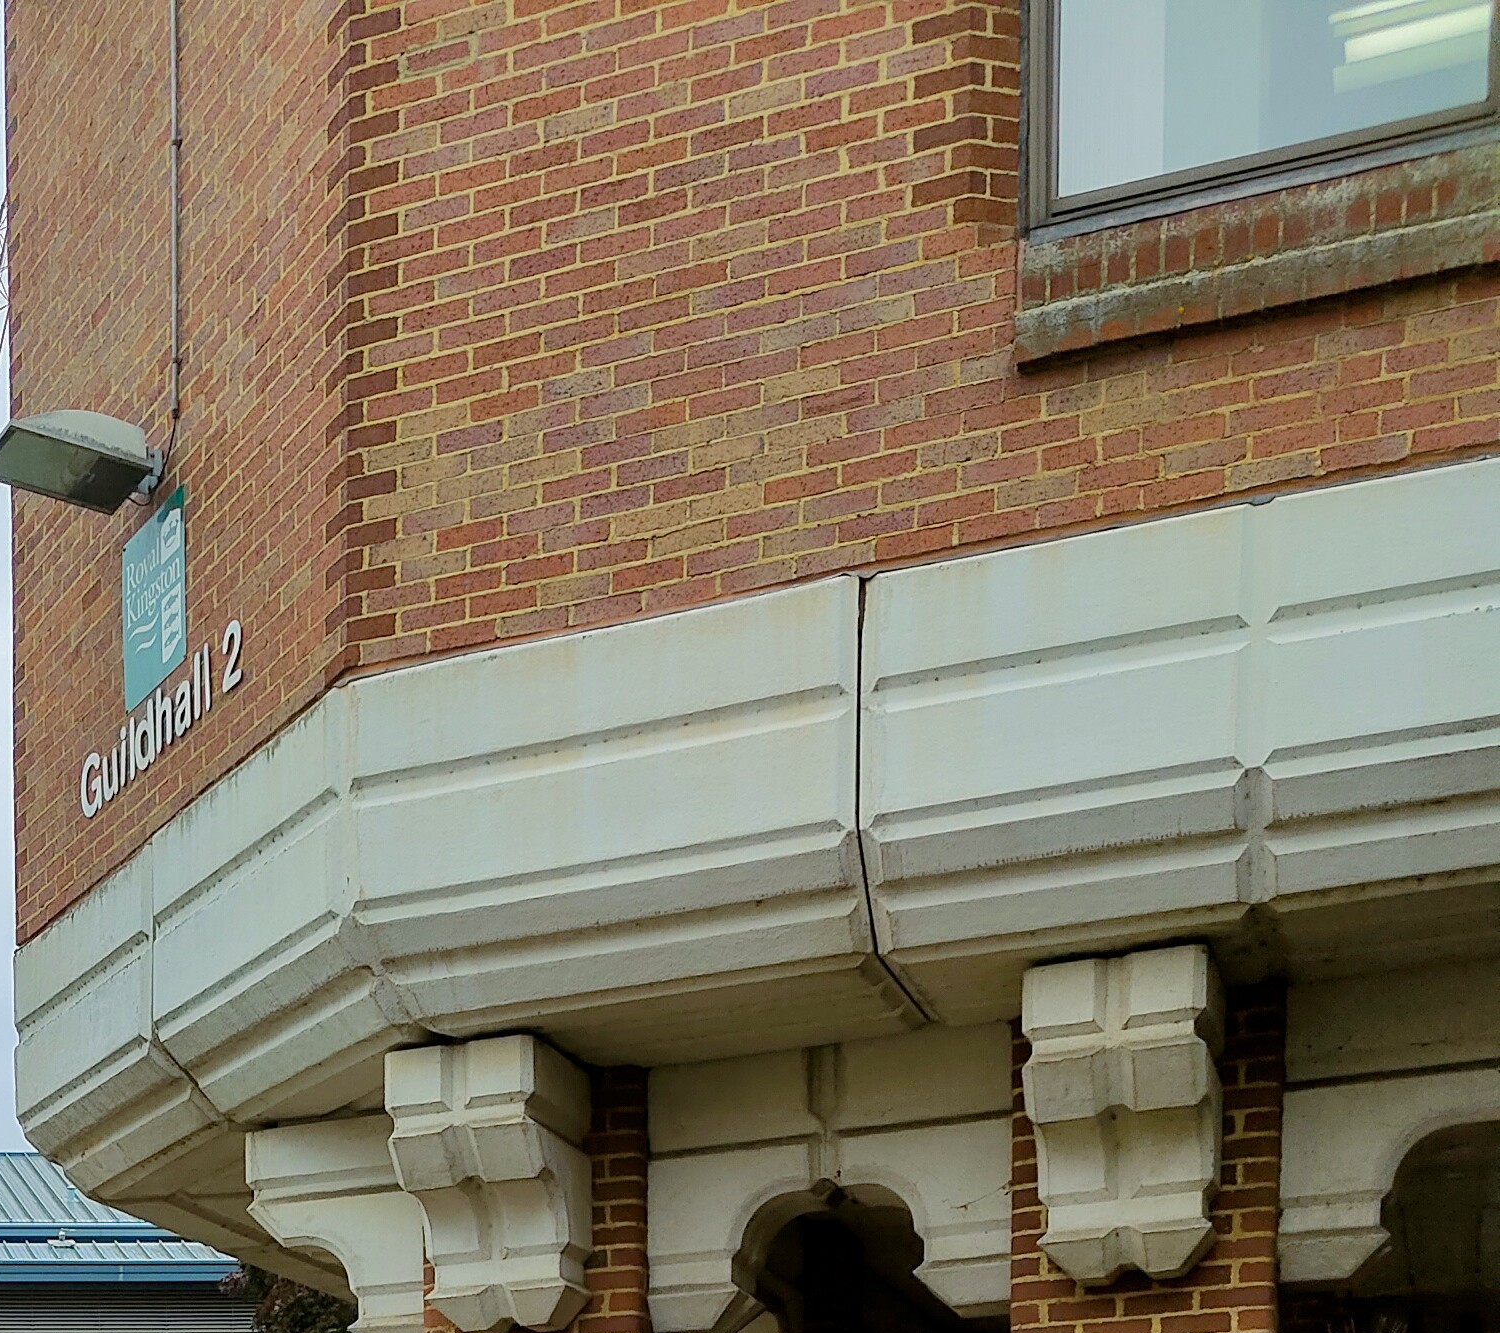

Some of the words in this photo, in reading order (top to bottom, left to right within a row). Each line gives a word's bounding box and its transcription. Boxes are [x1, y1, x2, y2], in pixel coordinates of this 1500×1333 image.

[126, 537, 160, 594] Royal
[126, 557, 181, 629] Kingston
[80, 642, 212, 819] Guildhall
[222, 619, 243, 694] 2
